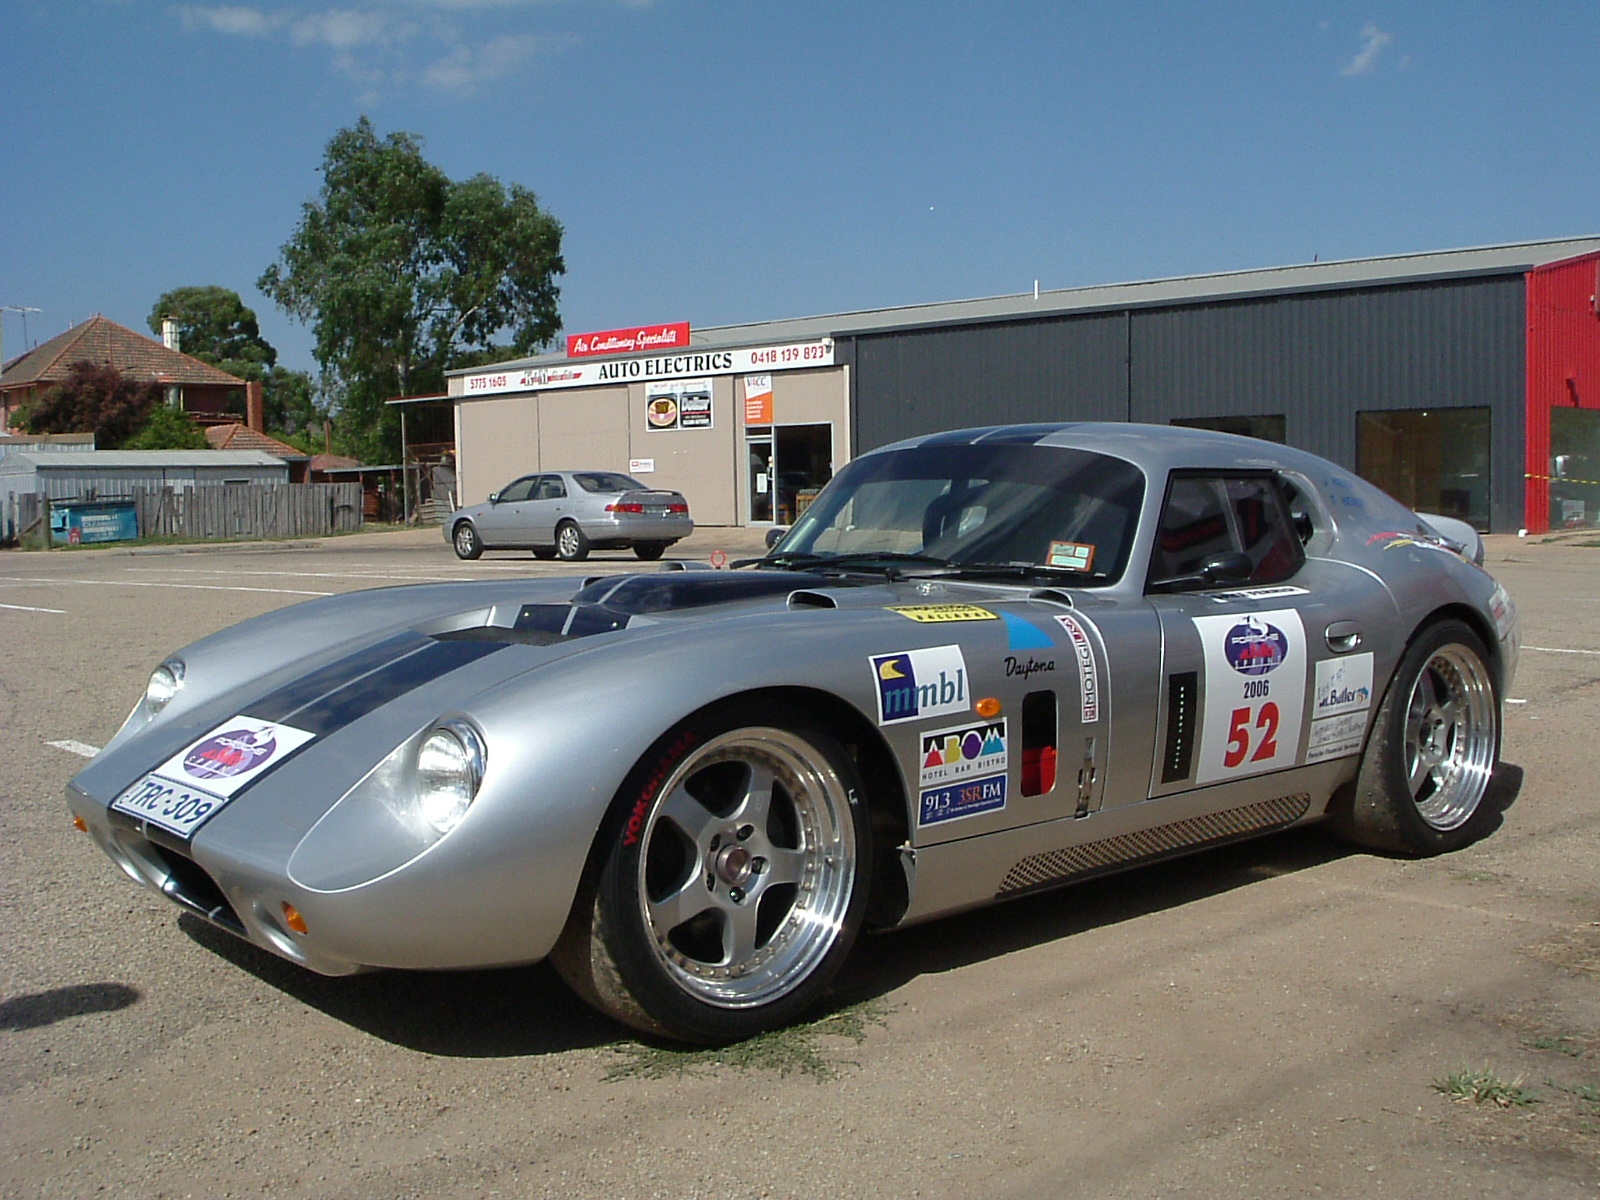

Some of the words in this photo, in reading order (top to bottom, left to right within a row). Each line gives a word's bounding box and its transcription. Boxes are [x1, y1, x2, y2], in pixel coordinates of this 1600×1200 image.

[574, 338, 588, 353] Air
[590, 336, 636, 351] Conditioning
[635, 328, 677, 349] Specialists
[598, 361, 641, 380] AUTO
[645, 353, 732, 376] ELECTRICS
[751, 350, 777, 364] 0418
[781, 348, 799, 362] 139
[803, 345, 825, 360] 823
[470, 377, 487, 390] 5775
[489, 375, 507, 388] 1605
[1231, 632, 1280, 644] PORSCHE
[1004, 656, 1056, 680] Daytona
[1078, 643, 1096, 705] MOTEGI
[884, 669, 966, 715] mmbl
[1243, 680, 1270, 698] 2006
[214, 736, 268, 756] PORSCHE
[922, 726, 1007, 769] ABOM
[1222, 702, 1280, 769] 52
[922, 768, 949, 780] HOTEL
[954, 764, 972, 774] BAR
[977, 756, 1006, 770] BISTRO
[925, 792, 951, 812] 91.3
